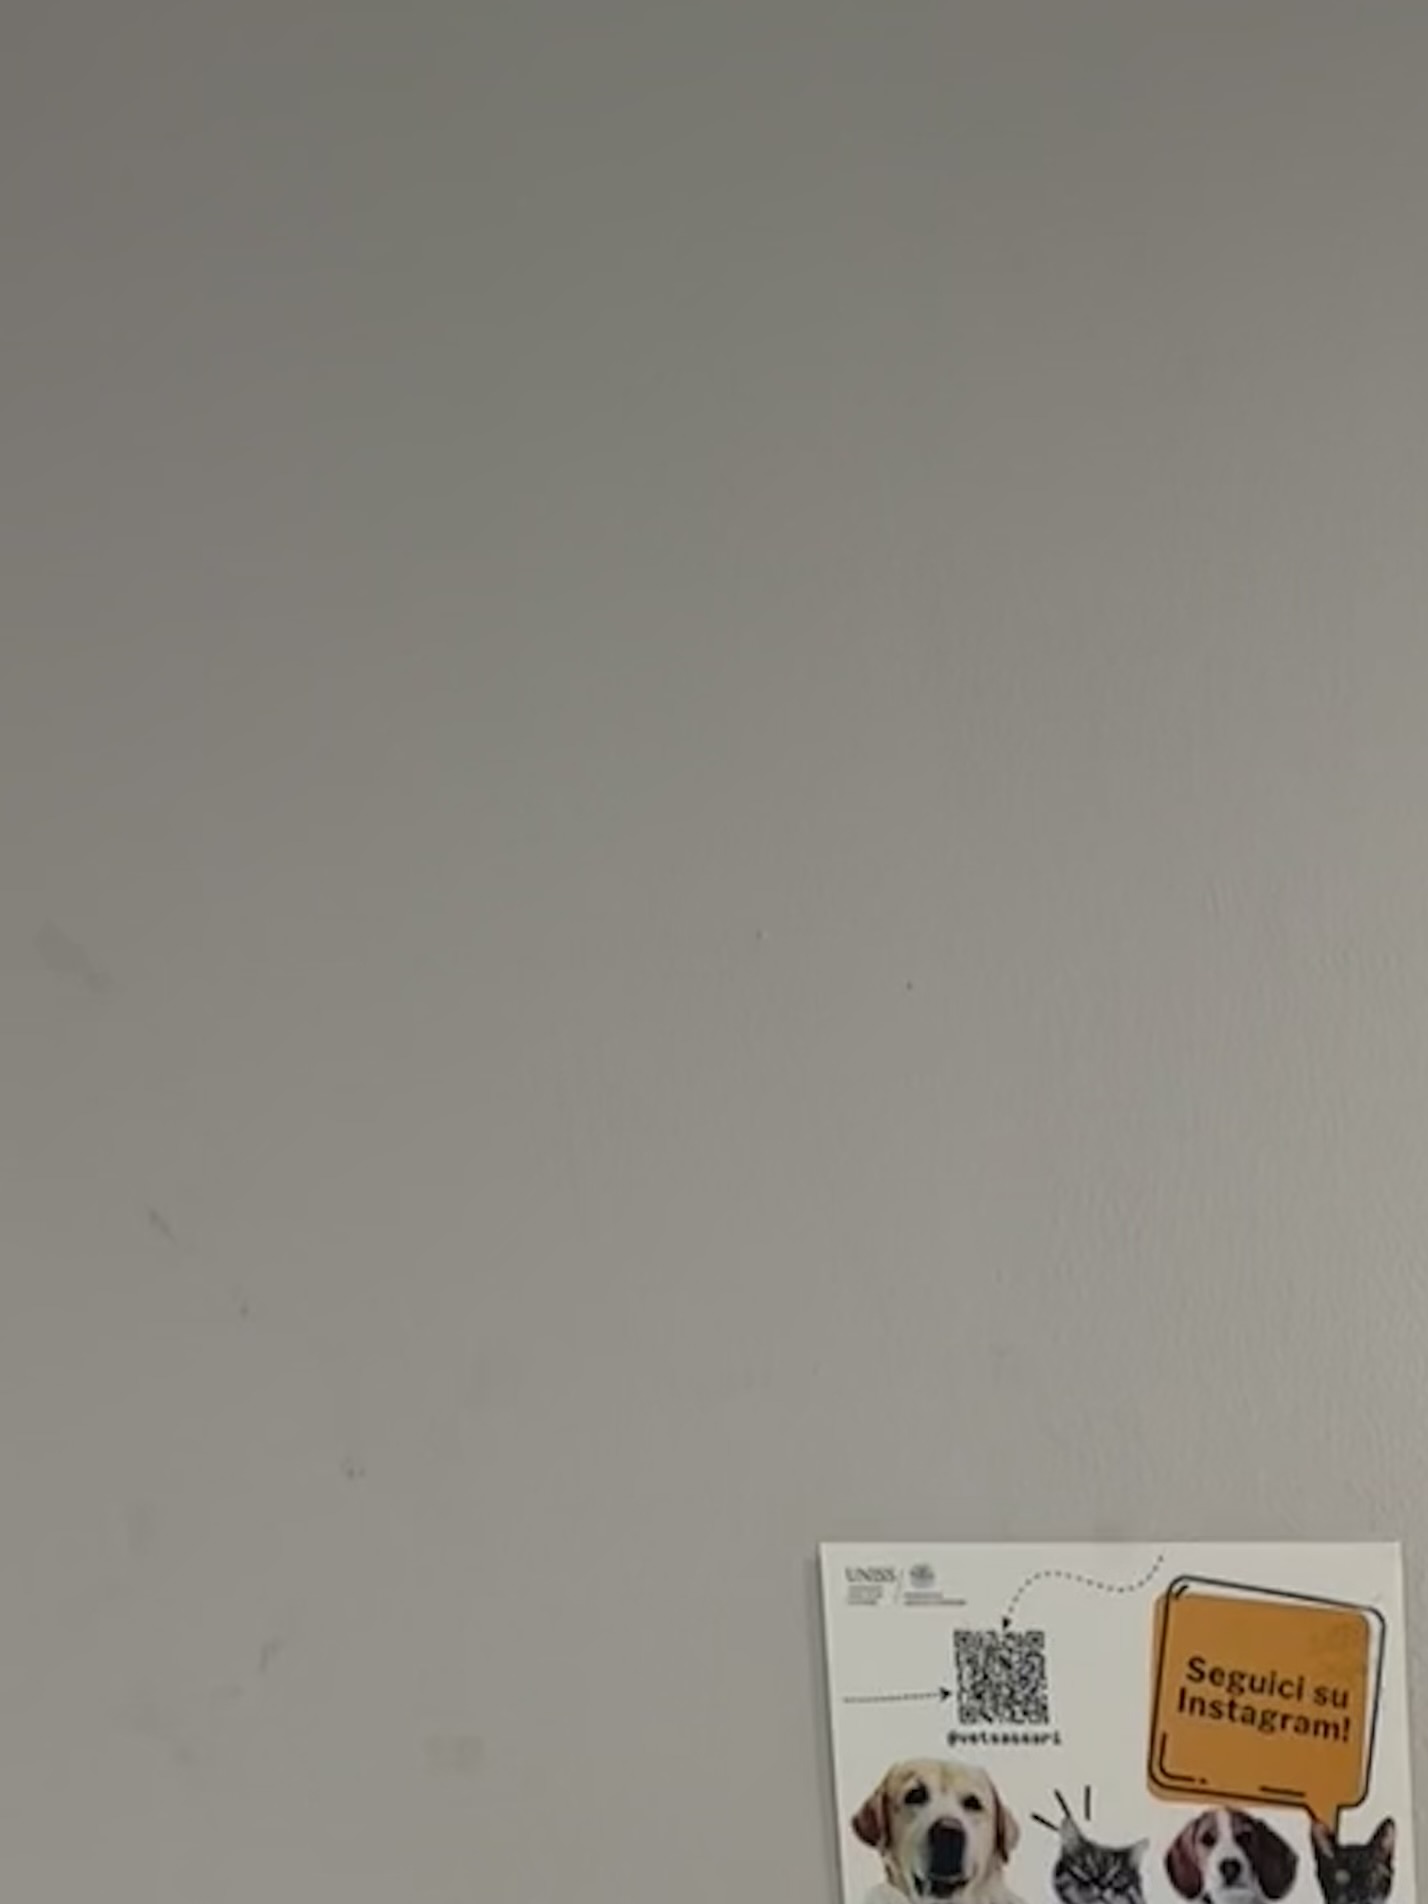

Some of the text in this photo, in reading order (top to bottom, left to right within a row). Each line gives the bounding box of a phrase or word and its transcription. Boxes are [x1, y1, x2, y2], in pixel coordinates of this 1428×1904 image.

[1186, 1656, 1349, 1710] Seguici su
[1178, 1686, 1351, 1743] Instagram!
